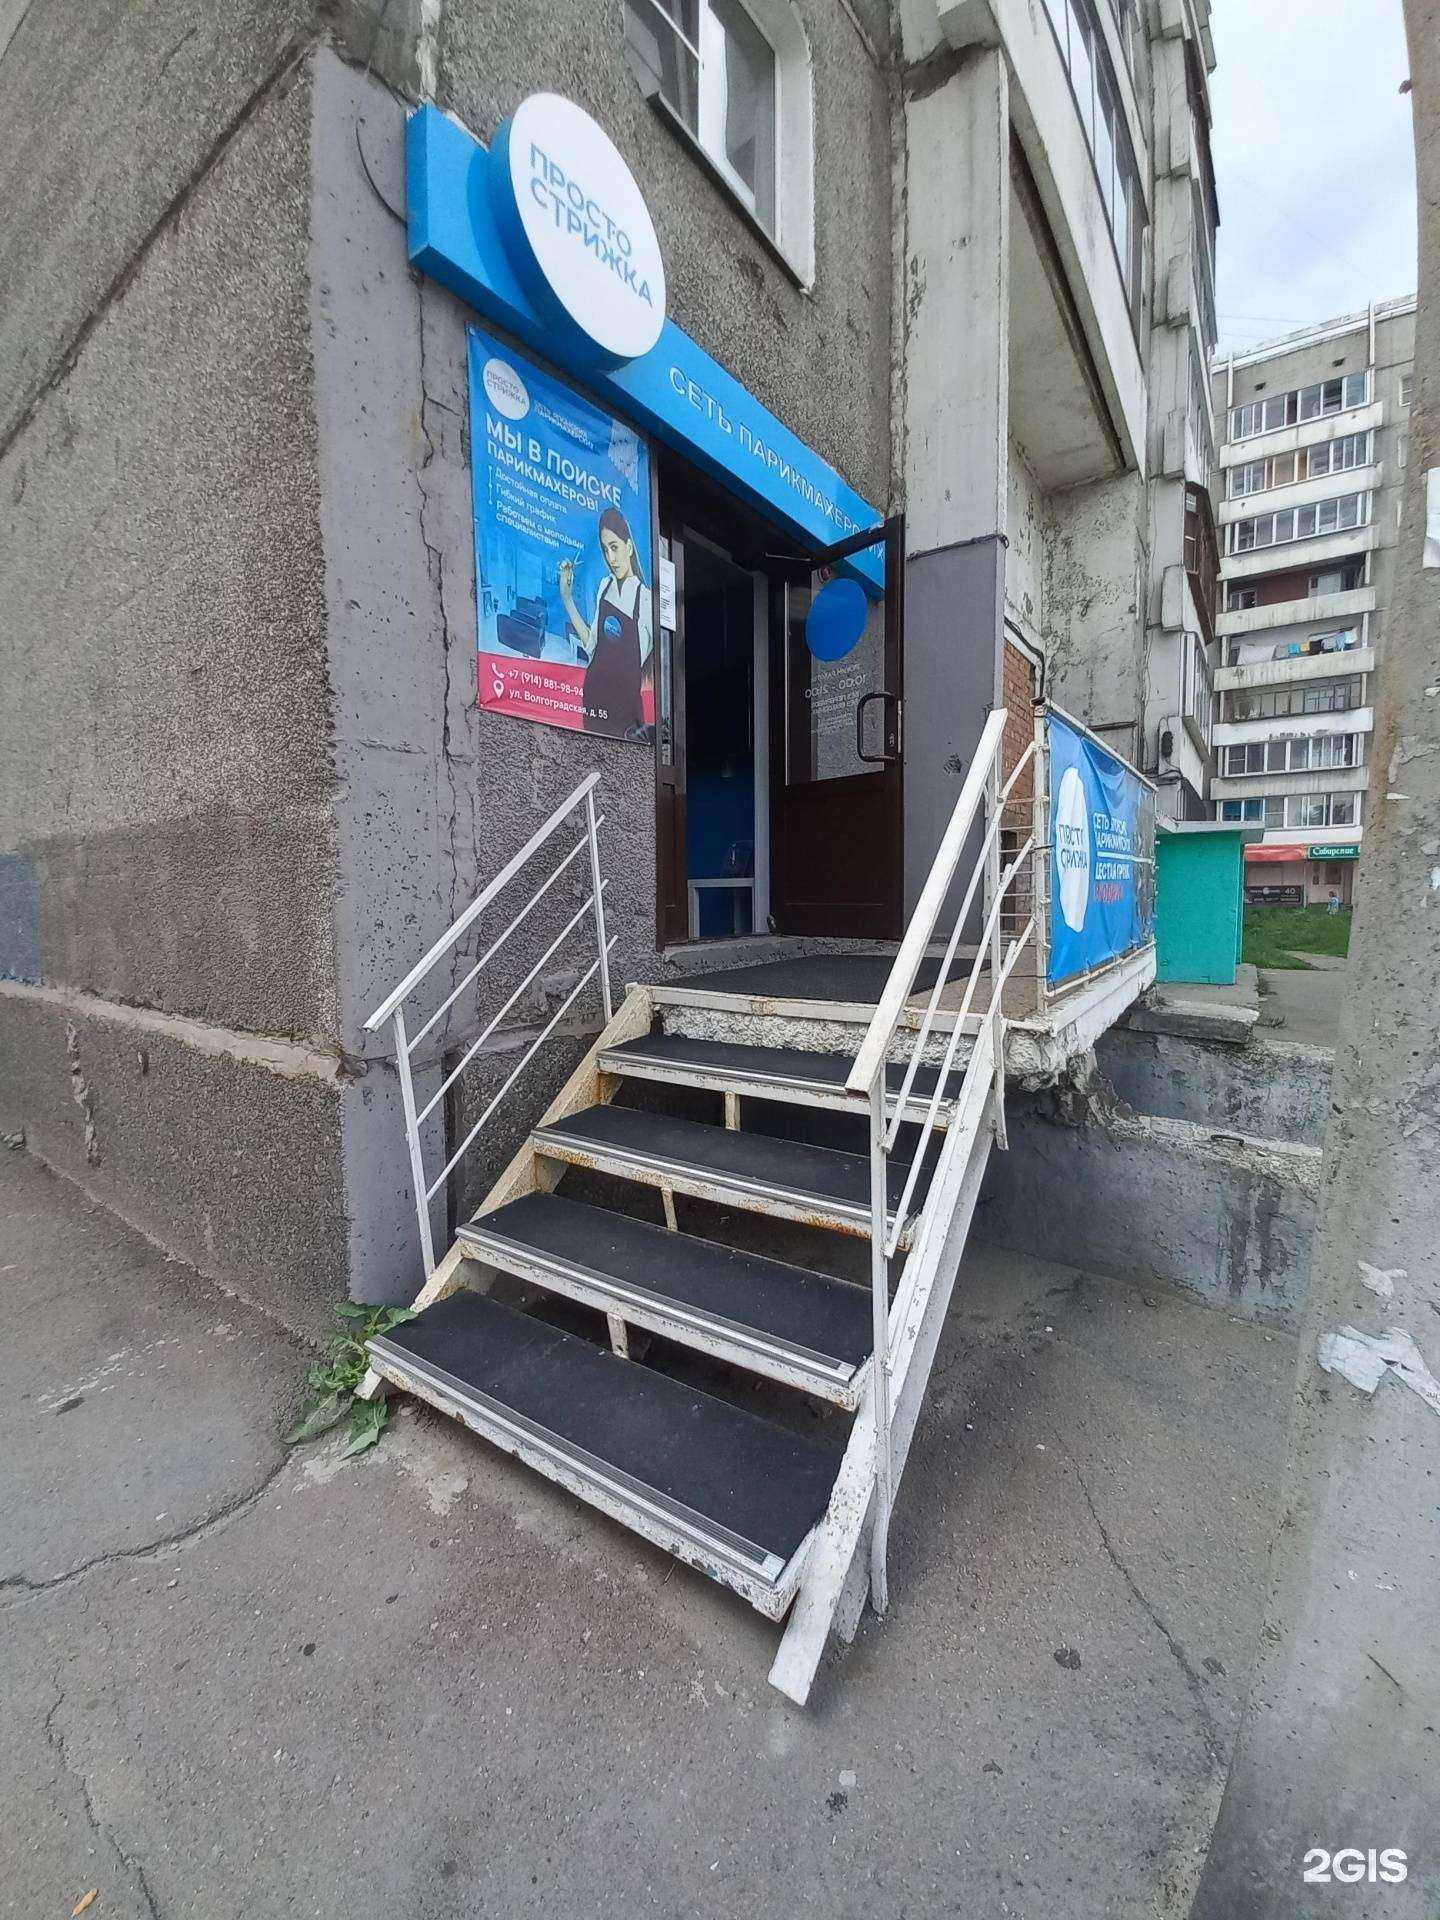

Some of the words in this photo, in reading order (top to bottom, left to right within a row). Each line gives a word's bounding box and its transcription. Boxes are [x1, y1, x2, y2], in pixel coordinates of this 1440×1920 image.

[530, 142, 632, 256] ПРОСТО
[530, 177, 653, 308] СТРИЖКА
[669, 367, 733, 434] СЕТЬ
[486, 412, 522, 454] МЫ
[528, 436, 542, 463] В
[547, 448, 622, 509] ПОИСКЕ
[508, 669, 519, 680] +7
[521, 672, 542, 688] (914)
[509, 688, 522, 699] ул.
[524, 691, 589, 716] Волгоградская,
[590, 709, 597, 718] д.
[598, 709, 608, 720] 55
